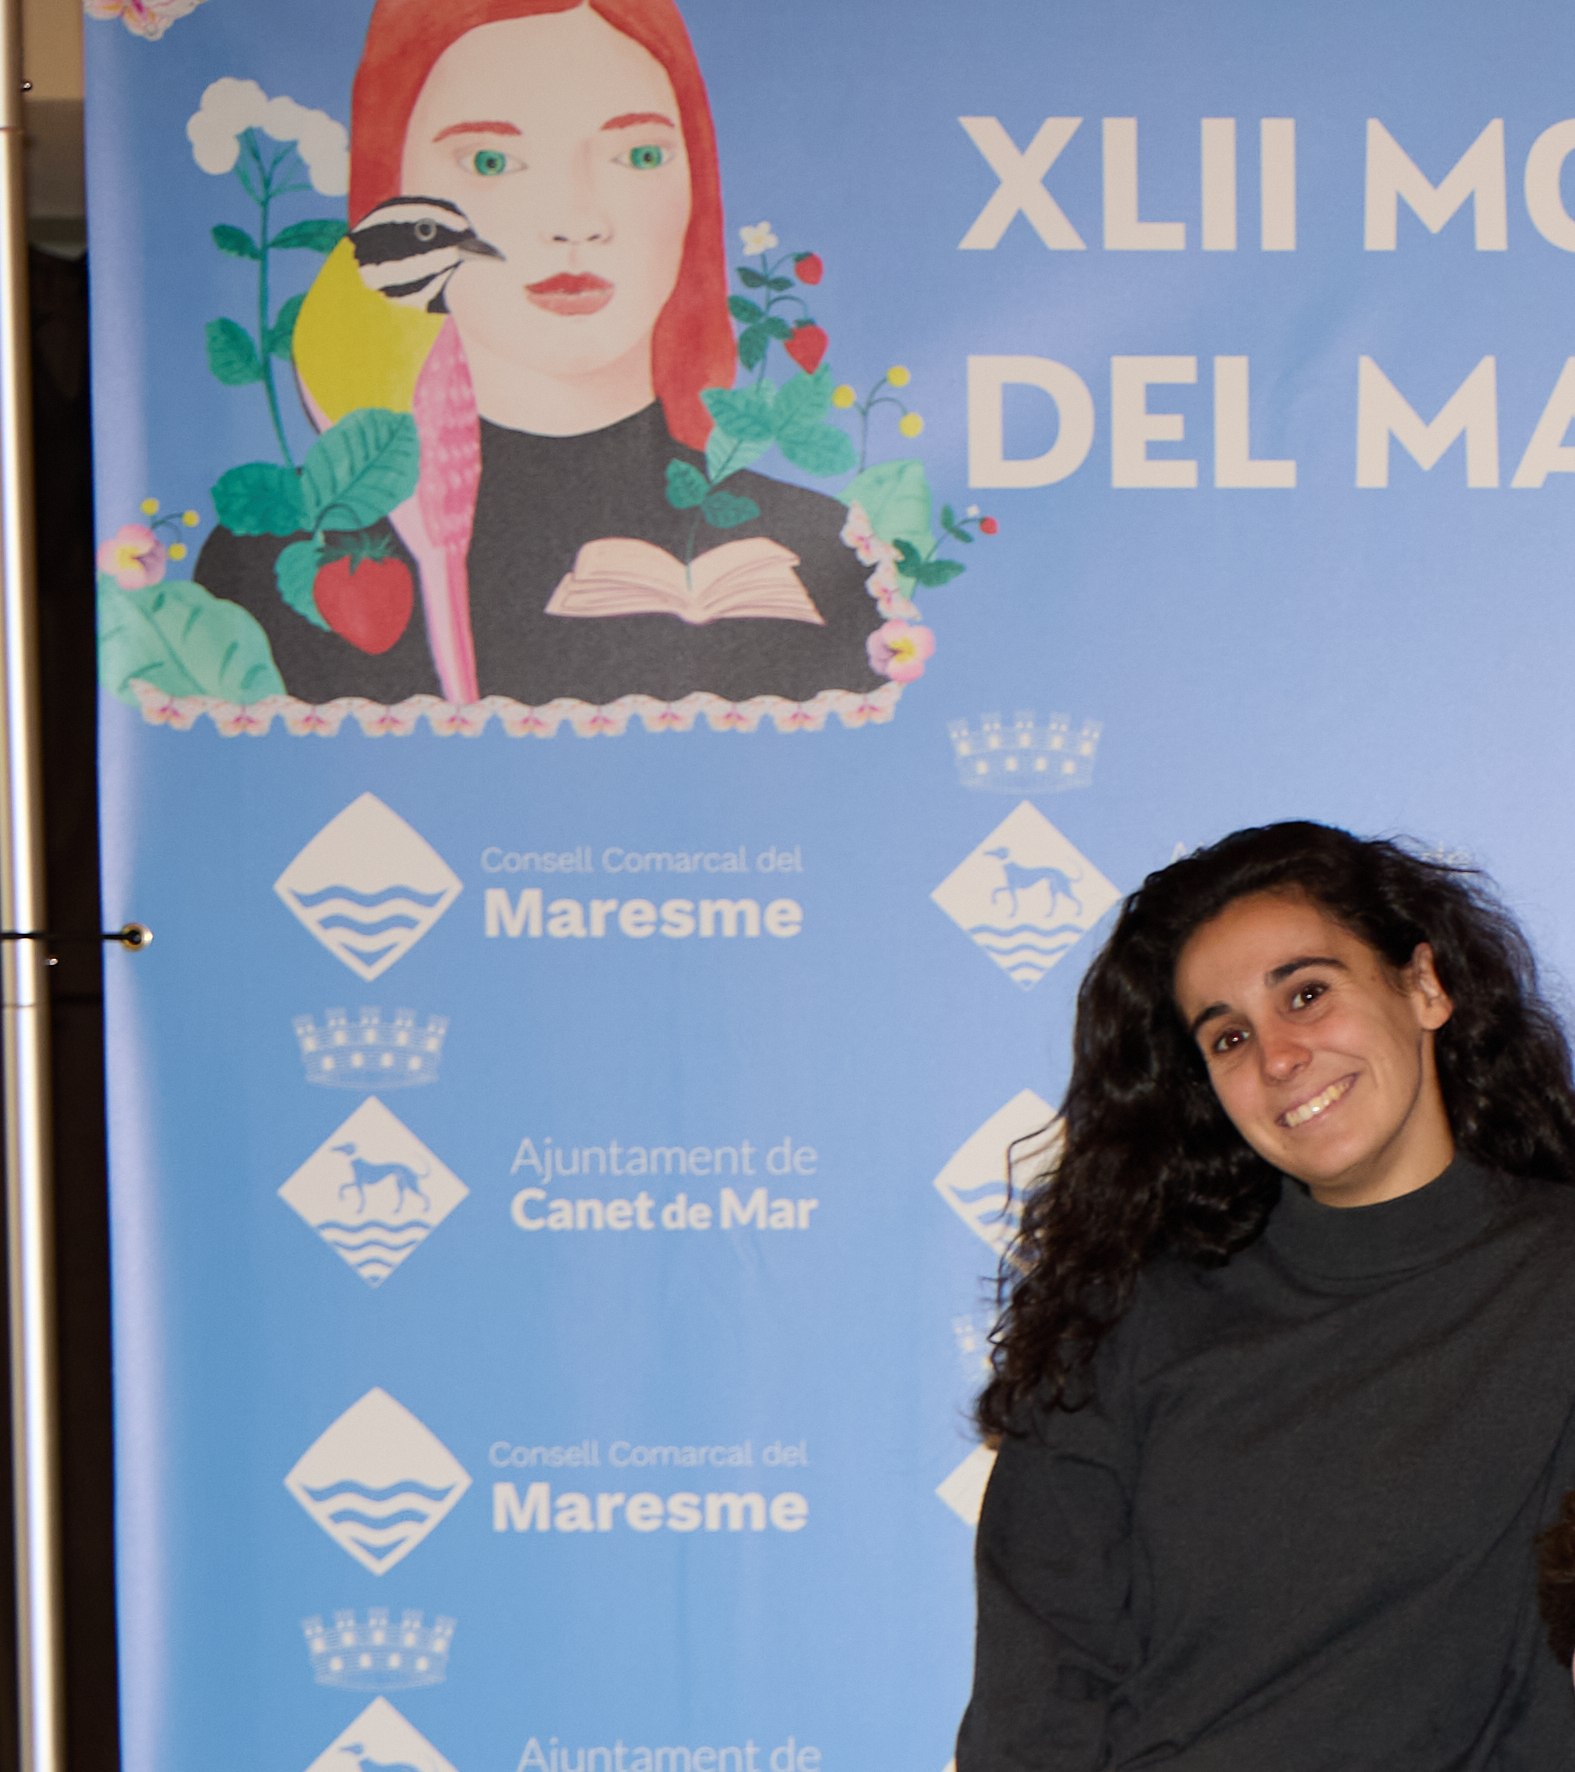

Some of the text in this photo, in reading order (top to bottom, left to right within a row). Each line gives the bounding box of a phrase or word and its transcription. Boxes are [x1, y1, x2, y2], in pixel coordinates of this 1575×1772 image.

[959, 117, 1295, 250] XLII
[968, 355, 1297, 490] DEL
[481, 846, 803, 873] Consell Comarcal del
[487, 890, 802, 937] Maresme
[511, 1137, 817, 1180] Ajuntament de
[512, 1188, 818, 1230] Canet de Mar
[489, 1440, 808, 1467] Consell Comarcal del
[495, 1483, 808, 1531] Maresme
